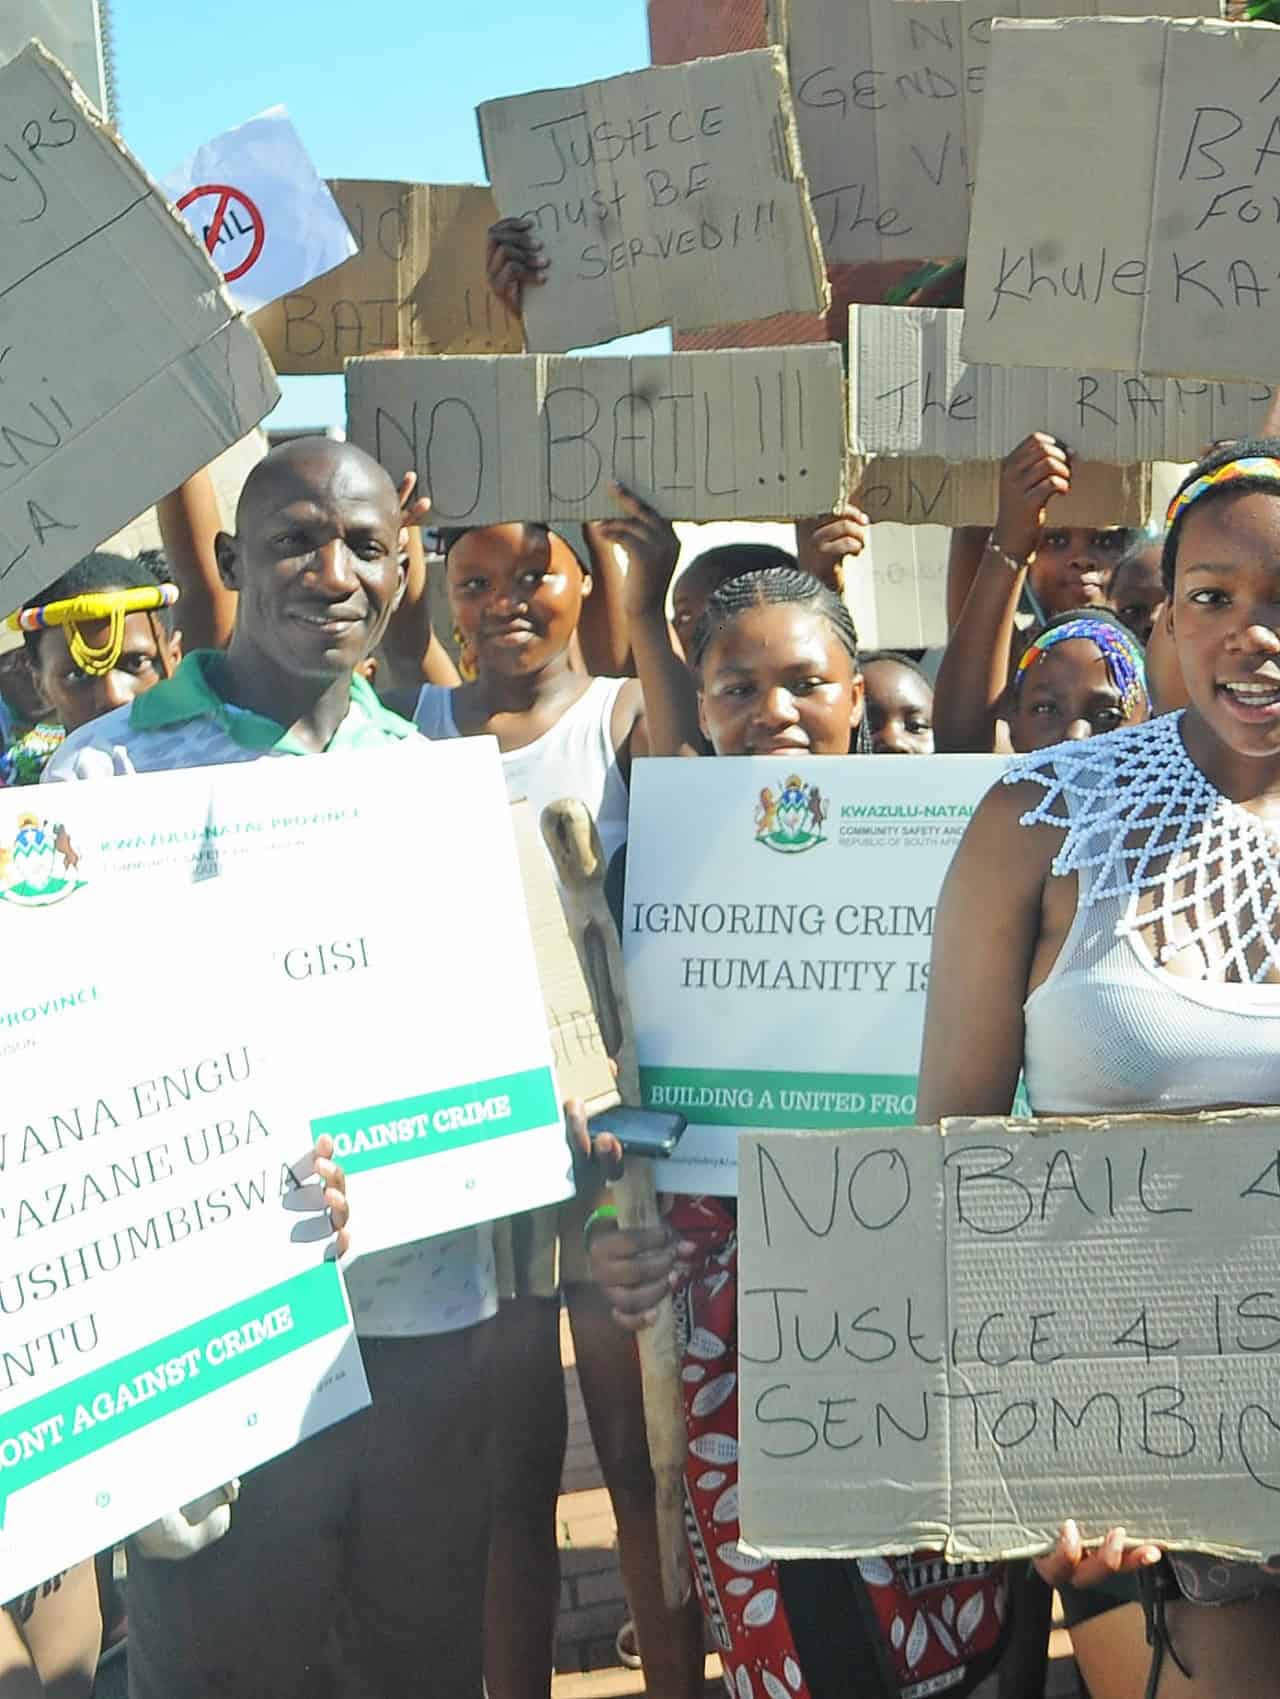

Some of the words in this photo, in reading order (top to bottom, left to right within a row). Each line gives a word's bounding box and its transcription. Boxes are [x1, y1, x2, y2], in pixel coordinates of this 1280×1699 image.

[798, 65, 987, 118] GENDE
[645, 162, 712, 208] BE
[202, 210, 254, 245] AIL
[376, 397, 484, 520] NO
[839, 826, 898, 836] COMMUNITY
[902, 826, 939, 835] SAFETY
[631, 903, 826, 936] IGNORING
[834, 903, 937, 937] CRIM
[680, 957, 896, 992] HUMANITY
[432, 1095, 512, 1133] CRIME
[651, 1085, 753, 1110] BUILDING
[758, 1088, 775, 1109] A
[779, 1090, 866, 1114] UNITED
[869, 1093, 917, 1116] FRO
[756, 1142, 912, 1248] NO
[942, 1144, 1194, 1235] BAIL
[1112, 1310, 1182, 1371] 4
[71, 1346, 202, 1435] AGAINST
[205, 1303, 294, 1366] CRIME
